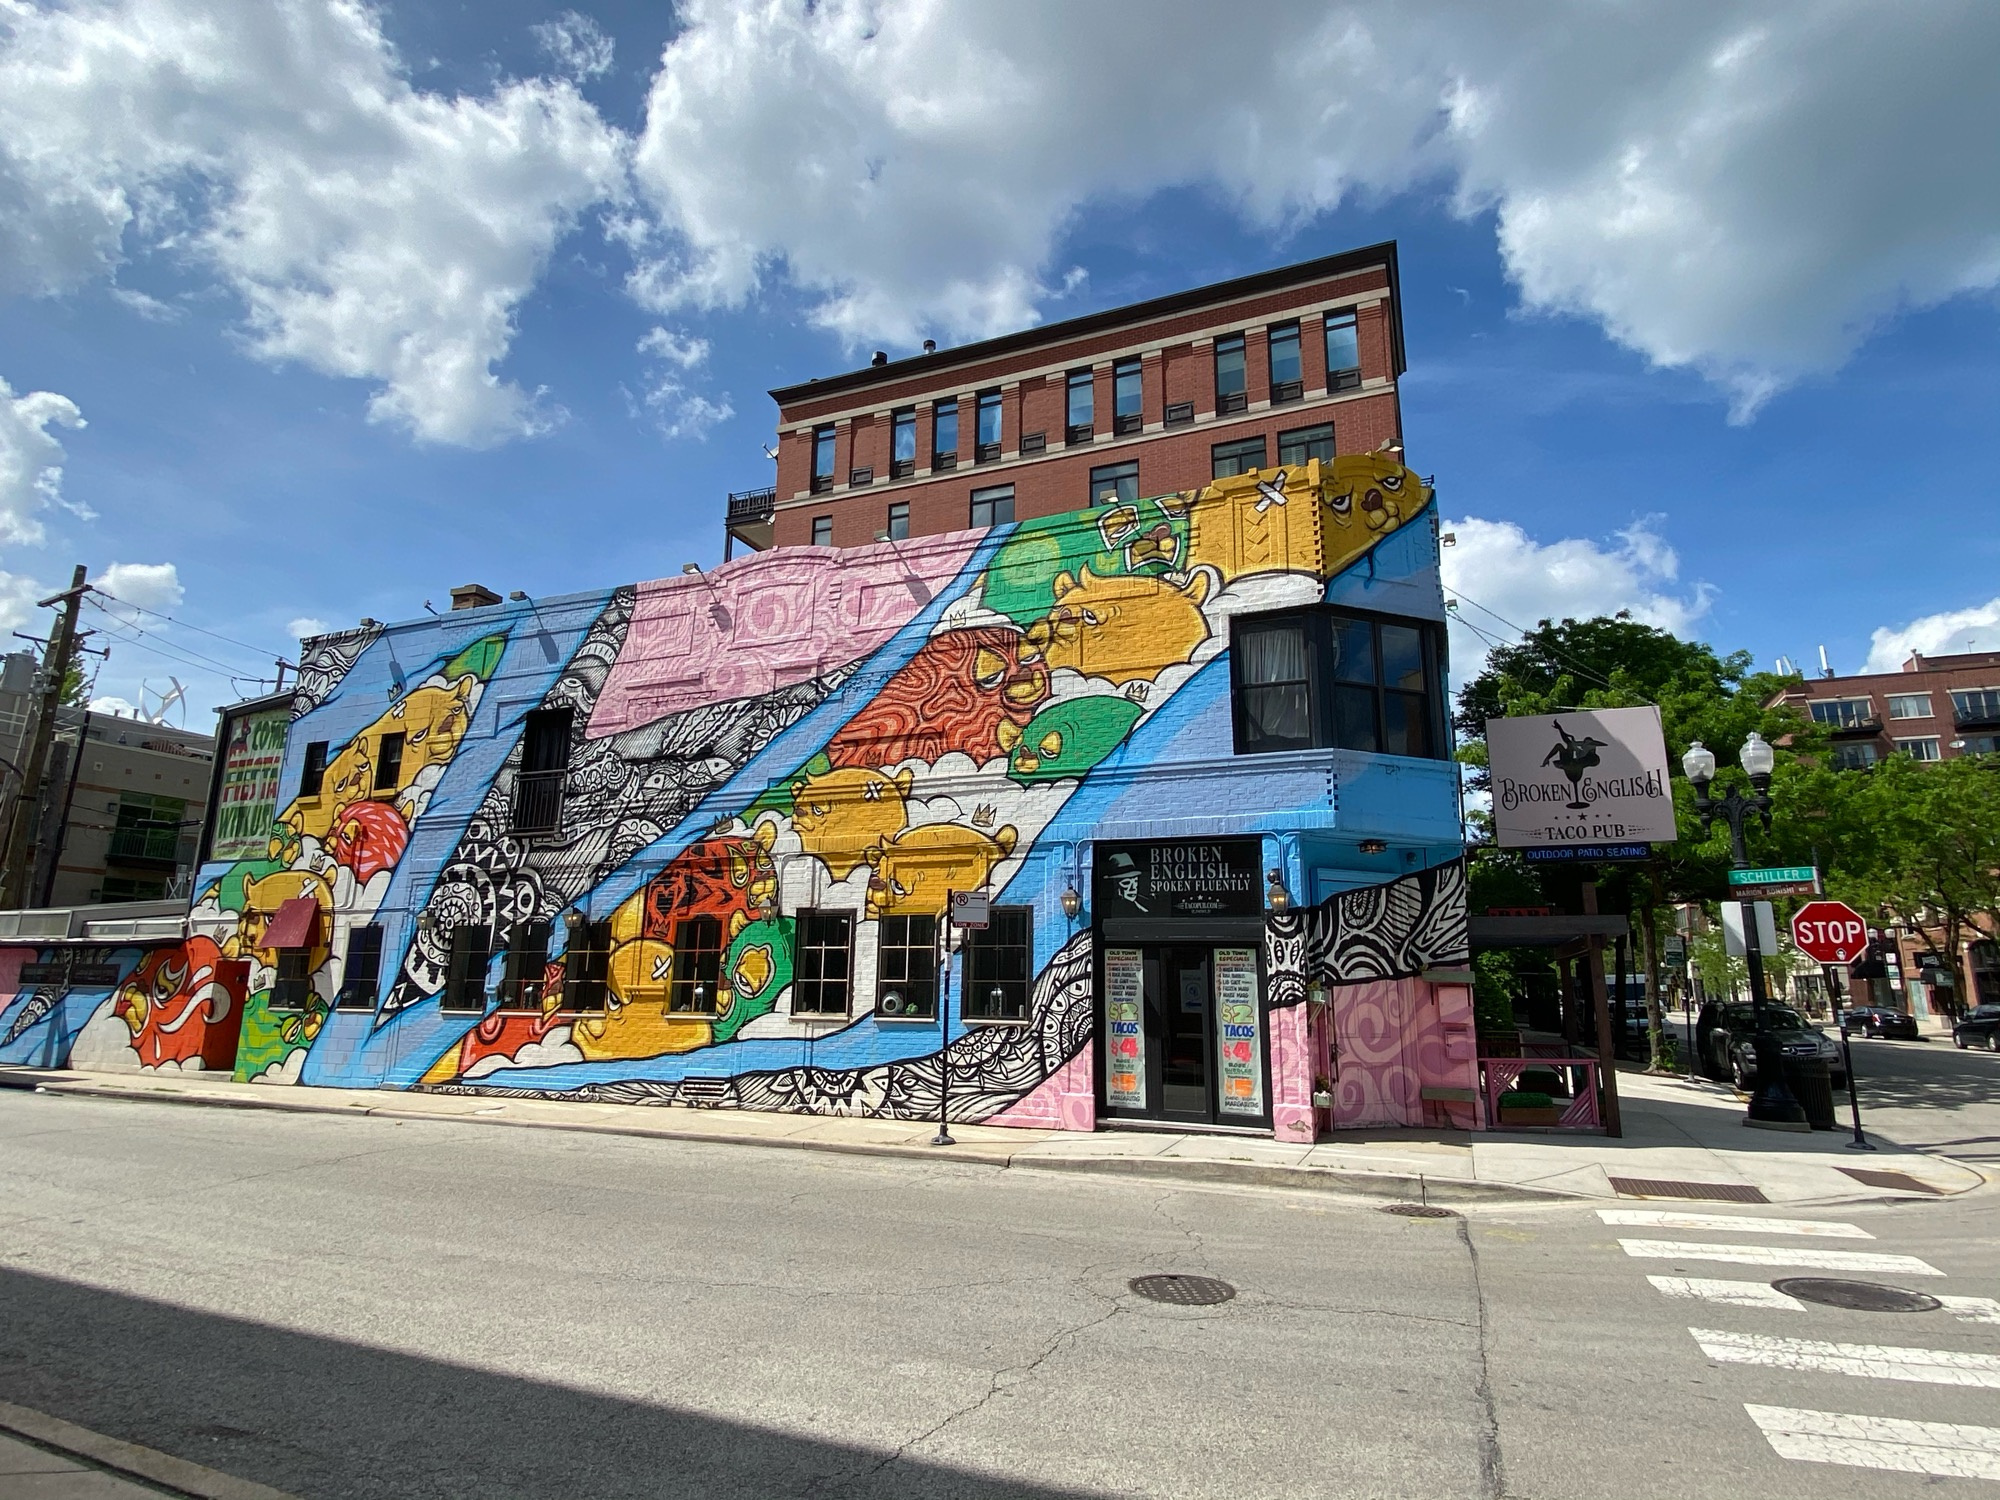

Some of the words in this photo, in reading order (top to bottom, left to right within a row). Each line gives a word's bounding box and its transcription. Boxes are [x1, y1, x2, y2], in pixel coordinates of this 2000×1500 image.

[252, 720, 288, 751] COME
[1498, 778, 1571, 811] BROKEN
[1582, 769, 1664, 802] ENGLISH
[1545, 825, 1587, 840] TACO
[1592, 824, 1626, 838] PUB
[1150, 846, 1222, 863] BROKEN
[1527, 850, 1574, 860] OUTDOOR
[1578, 849, 1603, 858] PATIO
[1606, 846, 1646, 857] SEATING
[1150, 863, 1250, 880] ENGLISH...
[1740, 870, 1800, 882] SCHILLER
[1150, 880, 1191, 892] SPOKEN
[1196, 879, 1250, 891] FLUENTLY
[1736, 889, 1762, 897] MARION
[1798, 921, 1861, 944] STOP
[1109, 1002, 1138, 1021] $2
[1221, 1002, 1254, 1024] $2
[1111, 1022, 1138, 1034] TACOS
[1224, 1024, 1254, 1038] TACOS
[1110, 1037, 1139, 1058] $4
[1223, 1041, 1252, 1063] $4
[1111, 1073, 1136, 1090] $5
